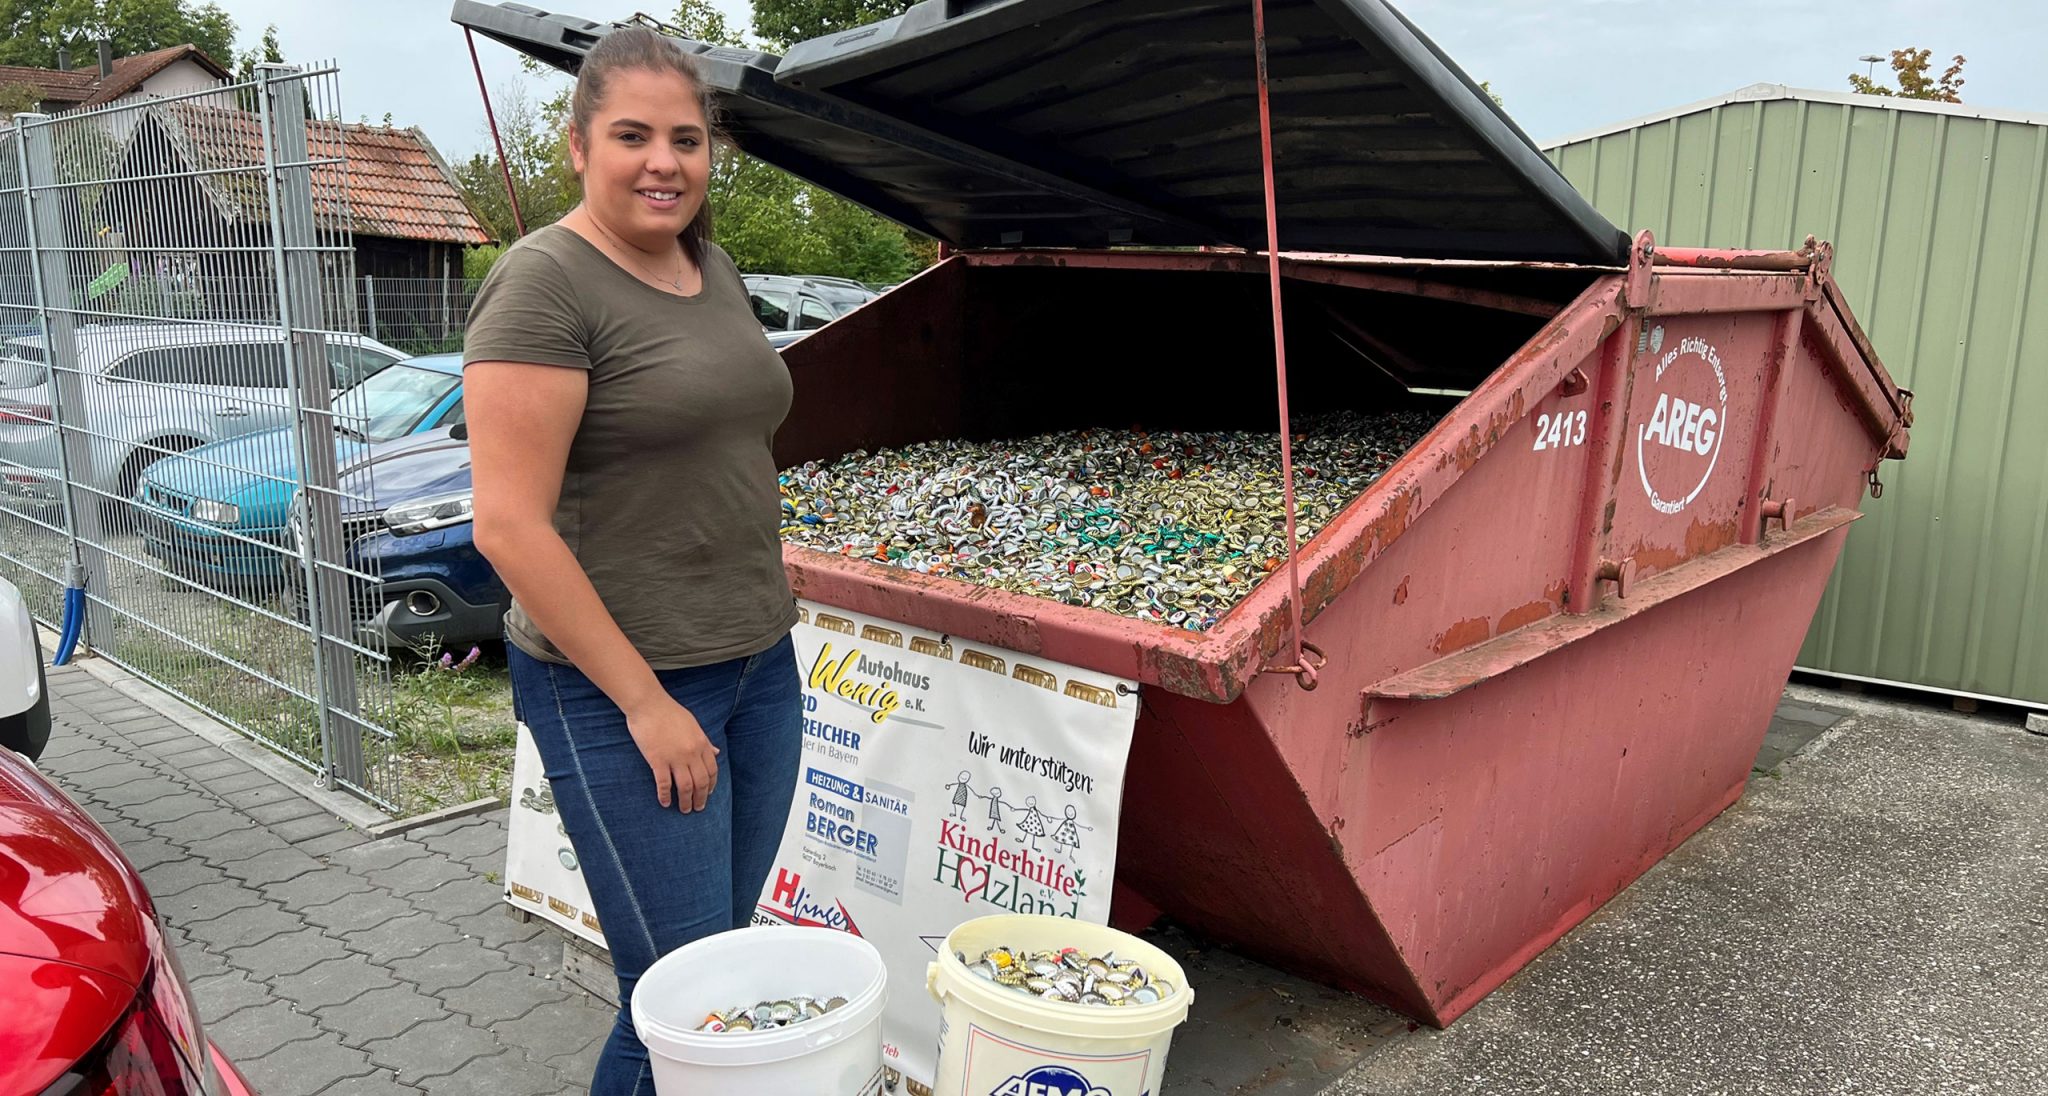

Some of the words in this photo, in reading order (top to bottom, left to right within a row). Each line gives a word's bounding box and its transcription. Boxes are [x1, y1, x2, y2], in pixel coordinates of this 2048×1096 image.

[1655, 345, 1678, 382] Alles
[1680, 335, 1708, 360] Richtig
[1533, 409, 1587, 451] 2413
[1644, 392, 1717, 456] AREG
[1650, 490, 1687, 515] Garantiert
[808, 642, 900, 724] Wenig
[857, 654, 930, 691] Autohaus
[817, 742, 826, 755] in
[829, 746, 859, 766] Bayern
[968, 731, 995, 758] Wir
[999, 745, 1094, 794] unterstützen:
[809, 792, 855, 823] Roman
[811, 772, 850, 796] HEIZUNG
[852, 787, 861, 800] &
[865, 791, 908, 816] SANITÄR
[807, 811, 878, 857] BERGER
[938, 818, 1076, 897] Kinderhilfe
